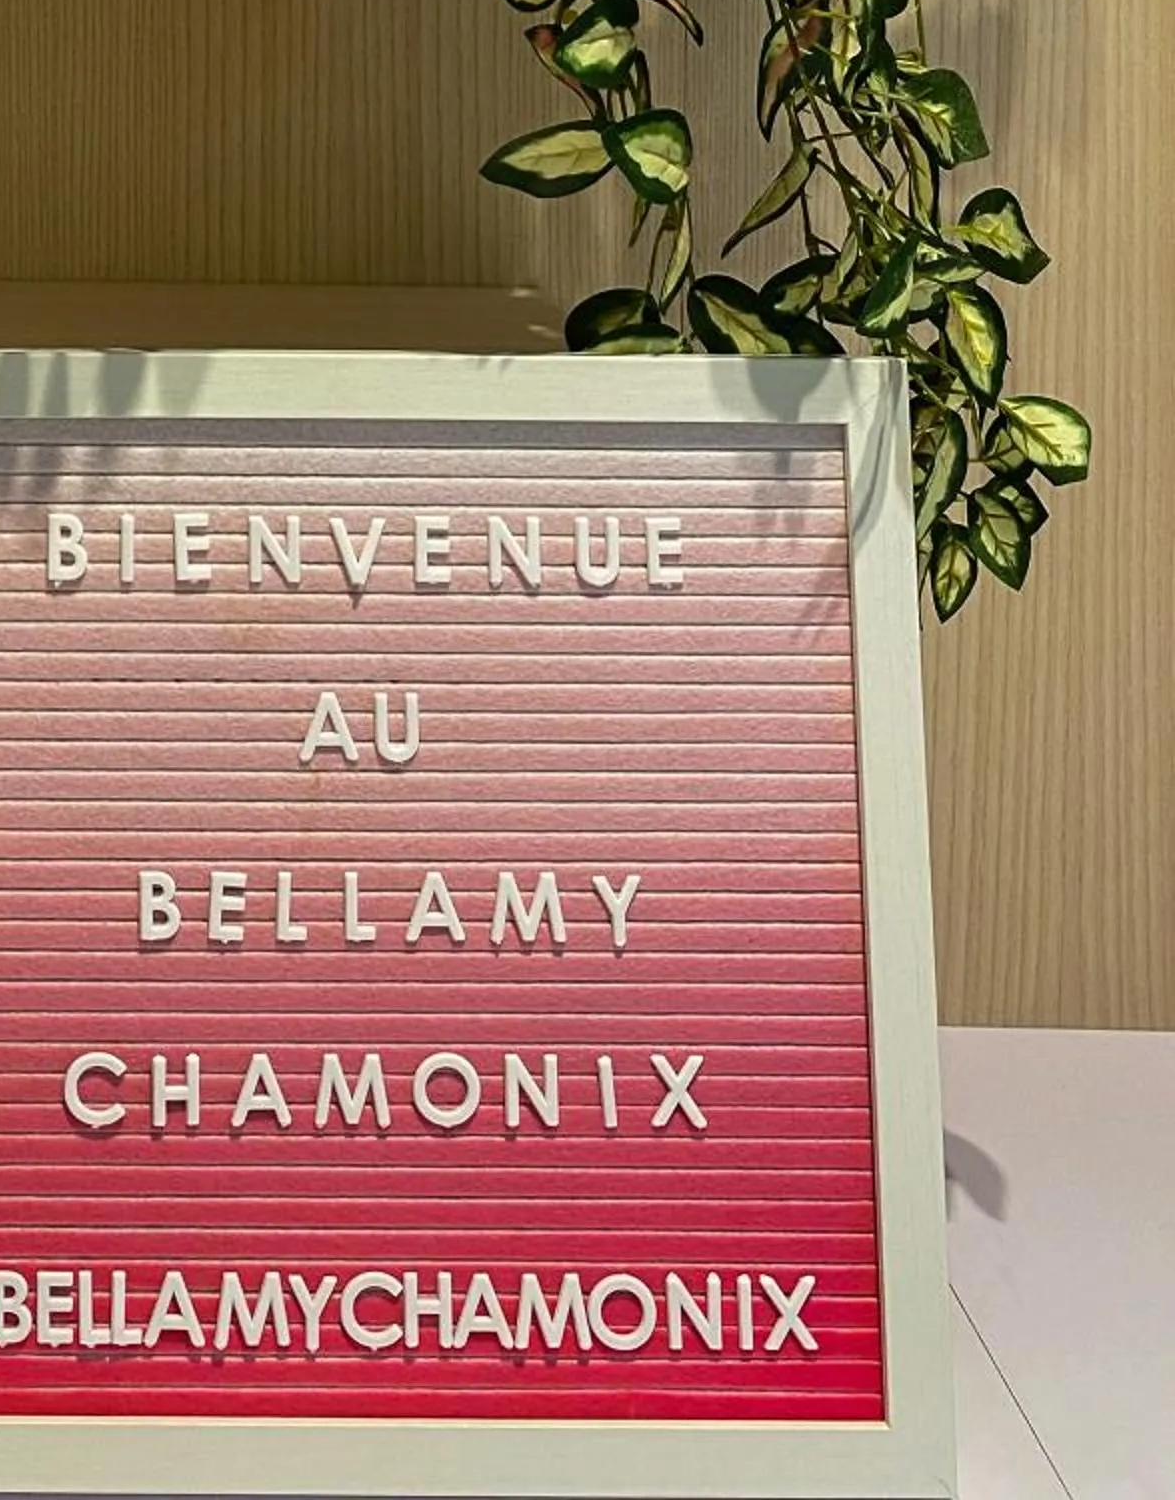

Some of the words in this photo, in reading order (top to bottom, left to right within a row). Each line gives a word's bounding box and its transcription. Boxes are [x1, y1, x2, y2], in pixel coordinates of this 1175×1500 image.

[46, 511, 685, 588] BIENVENUE
[300, 690, 422, 763] AU
[138, 869, 643, 947] BELLAMY
[64, 1051, 709, 1129] CHAMONIX
